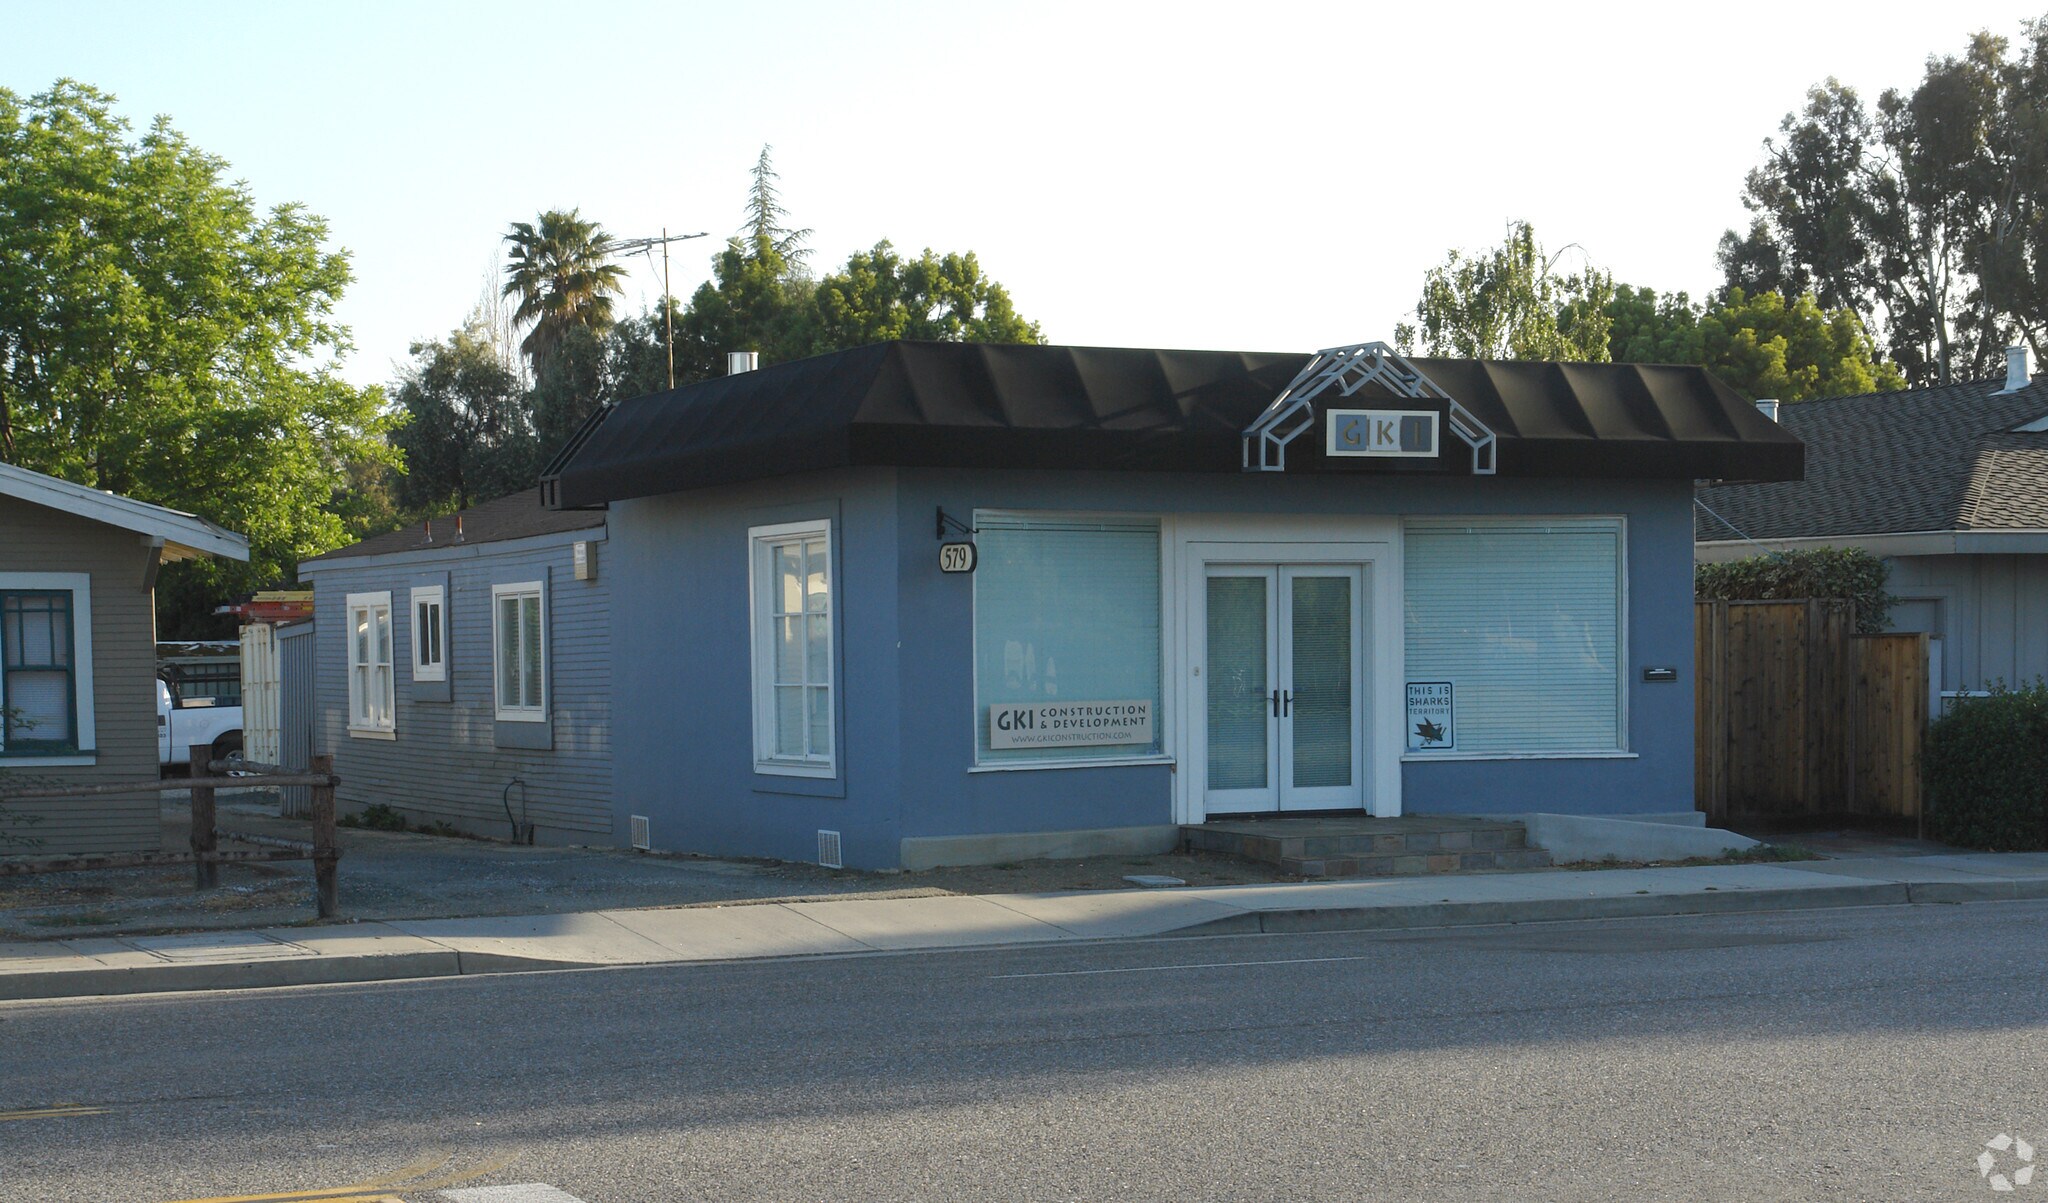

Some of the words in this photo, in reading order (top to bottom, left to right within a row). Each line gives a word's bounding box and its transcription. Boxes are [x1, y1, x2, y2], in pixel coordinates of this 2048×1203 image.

[1342, 419, 1421, 447] GKI
[945, 547, 967, 570] 579
[1409, 686, 1433, 695] THIS
[1439, 686, 1450, 695] IS
[1409, 697, 1450, 706] SHARKS
[997, 709, 1034, 731] GKI
[1040, 705, 1147, 718] CONSTRUCTION
[1040, 720, 1048, 730] &
[1053, 716, 1147, 730] DEVELOPMENT
